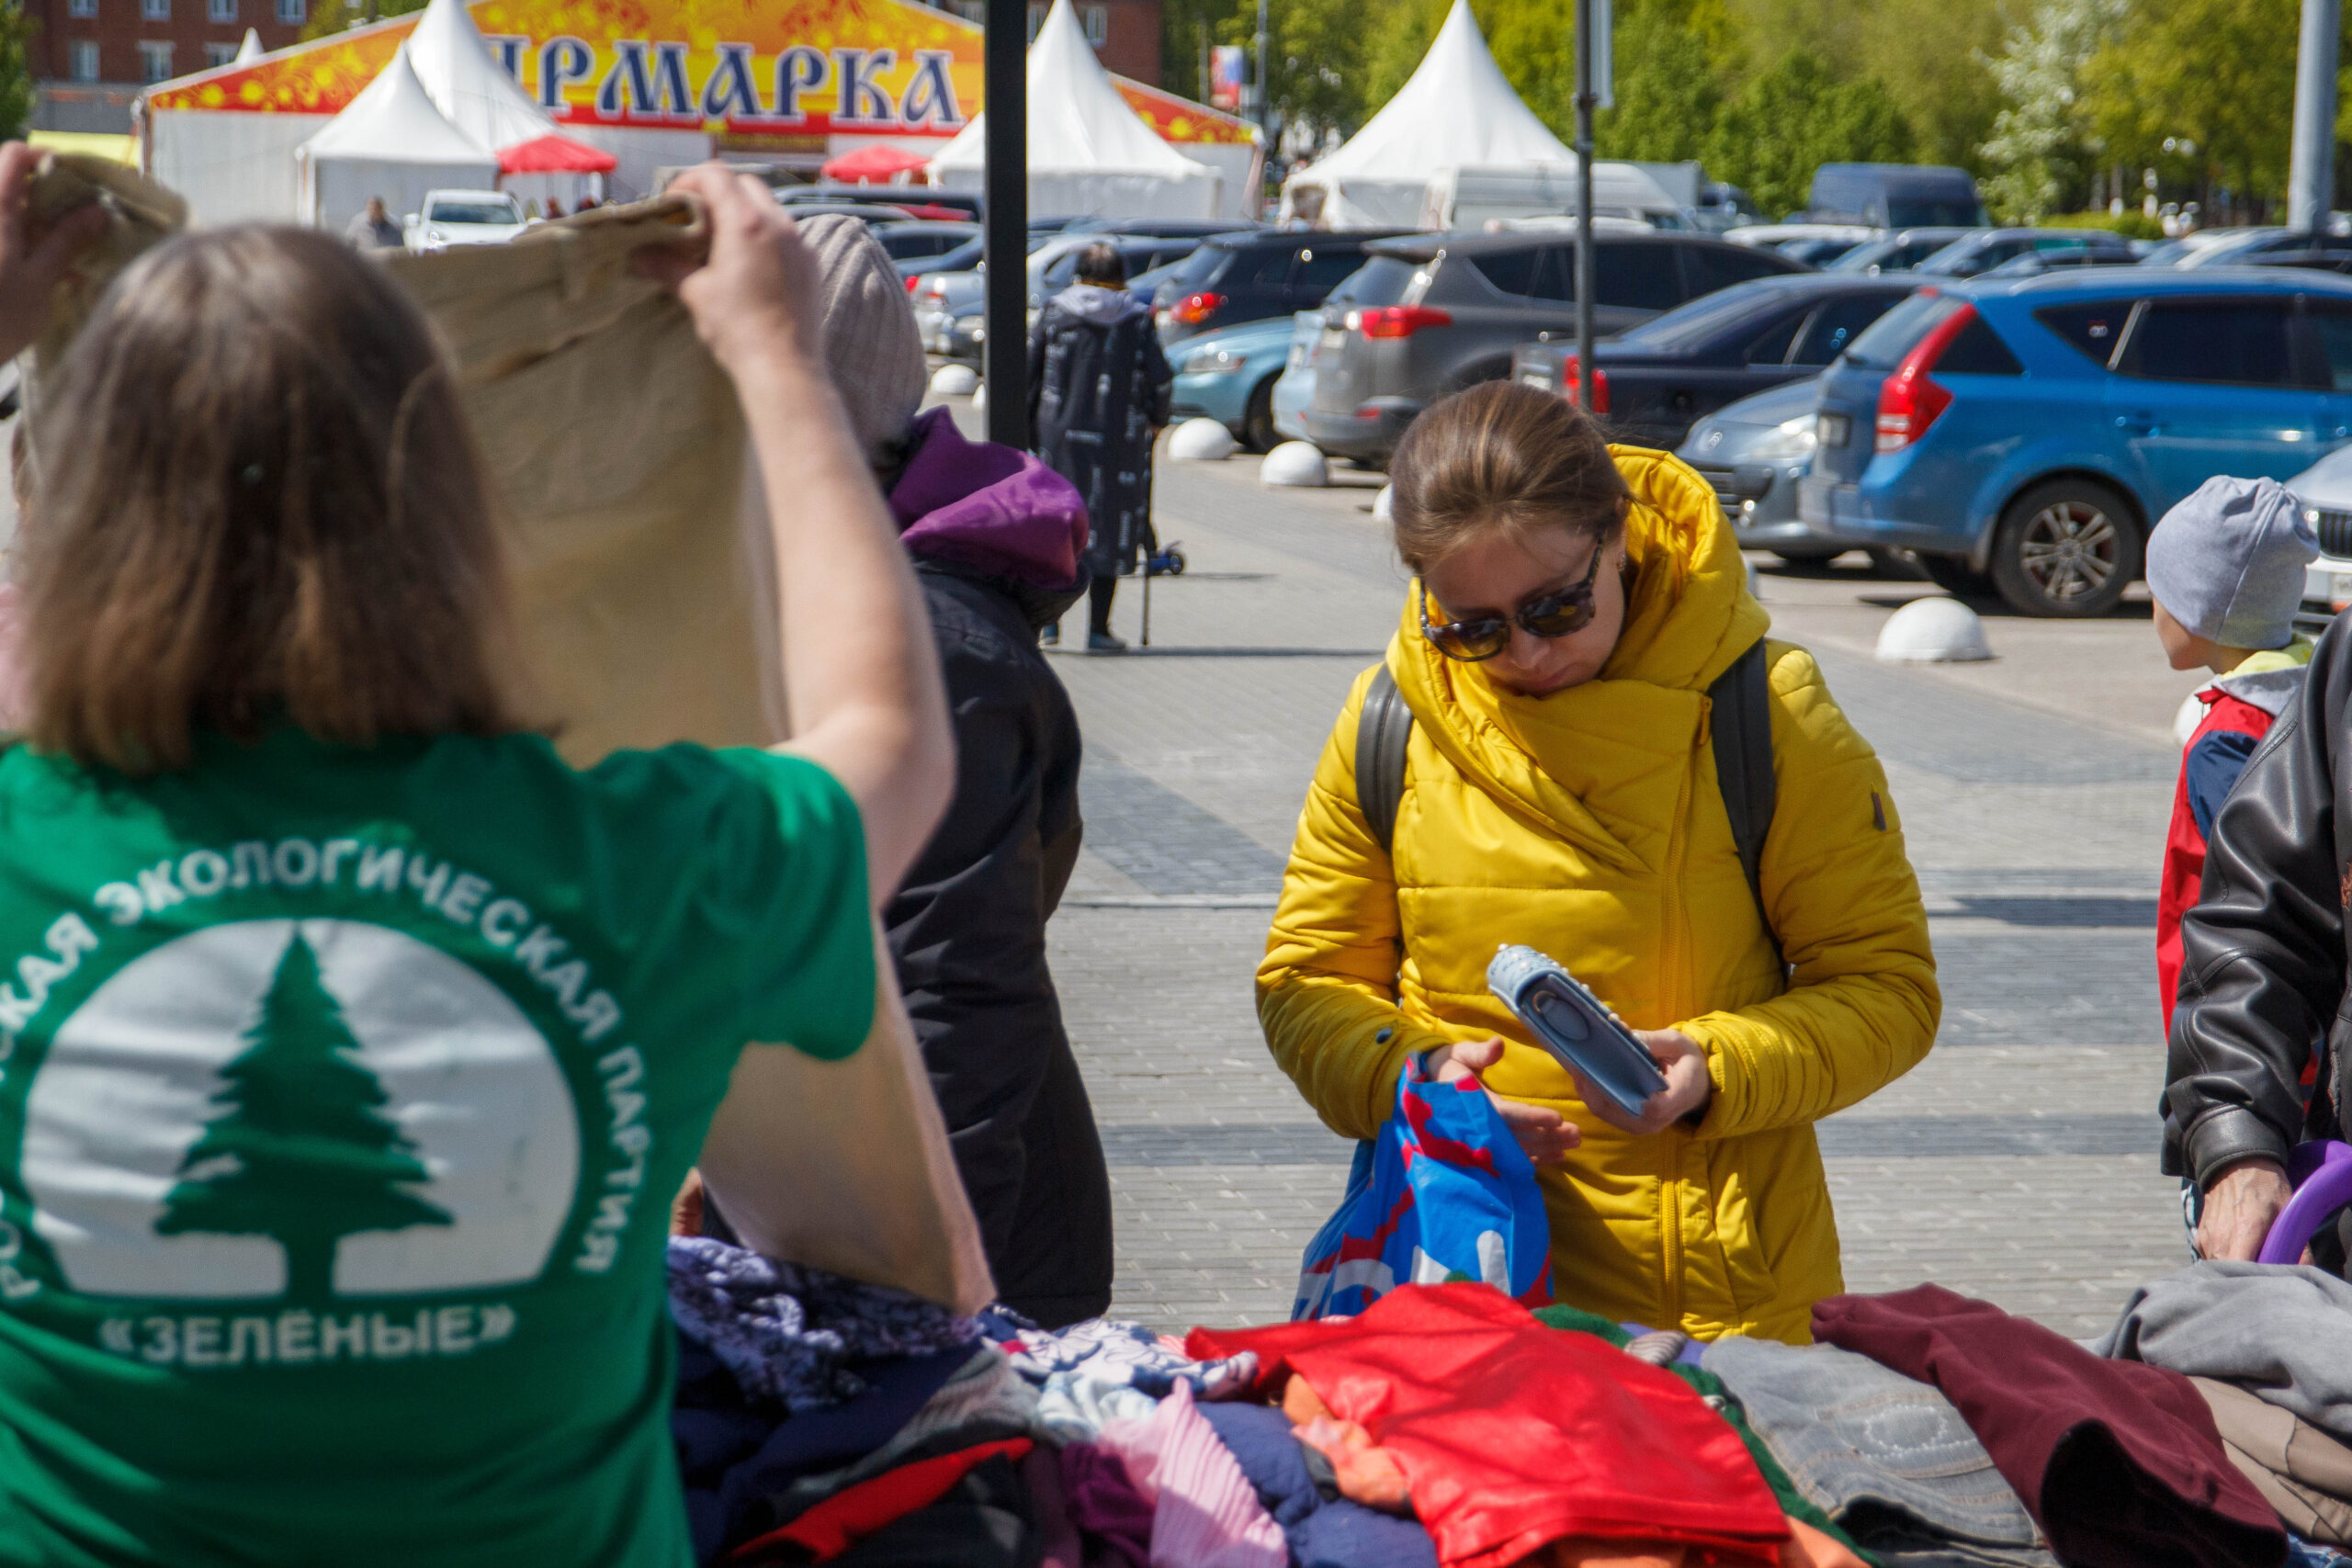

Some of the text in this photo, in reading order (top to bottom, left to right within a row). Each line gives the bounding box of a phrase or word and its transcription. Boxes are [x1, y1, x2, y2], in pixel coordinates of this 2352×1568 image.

[95, 838, 622, 1042] ЭКОЛОГИЧЕСКАЯ
[573, 1046, 651, 1273] ПАРТИЯ
[99, 1304, 516, 1365] «ЗЕЛЁНЫЕ»
